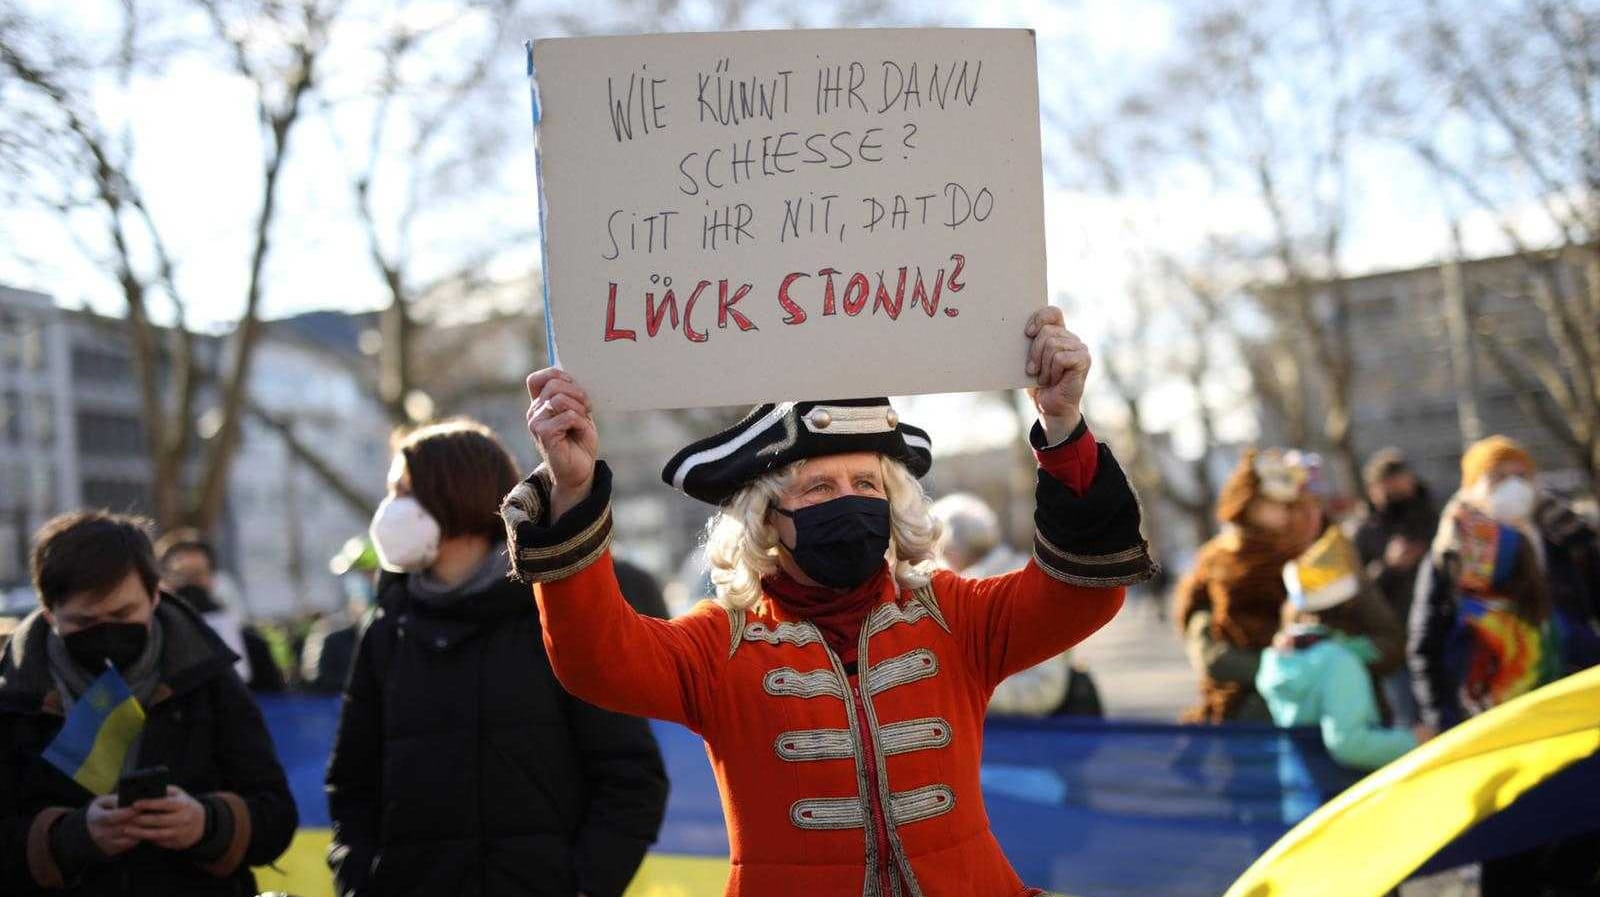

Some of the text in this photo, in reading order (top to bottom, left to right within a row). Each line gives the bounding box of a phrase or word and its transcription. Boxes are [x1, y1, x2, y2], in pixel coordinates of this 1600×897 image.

[697, 57, 793, 126] KÜNNT
[877, 59, 982, 114] DANN
[862, 193, 937, 233] DAT
[943, 181, 994, 231] DO
[603, 253, 966, 343] LÜCK STONN?
